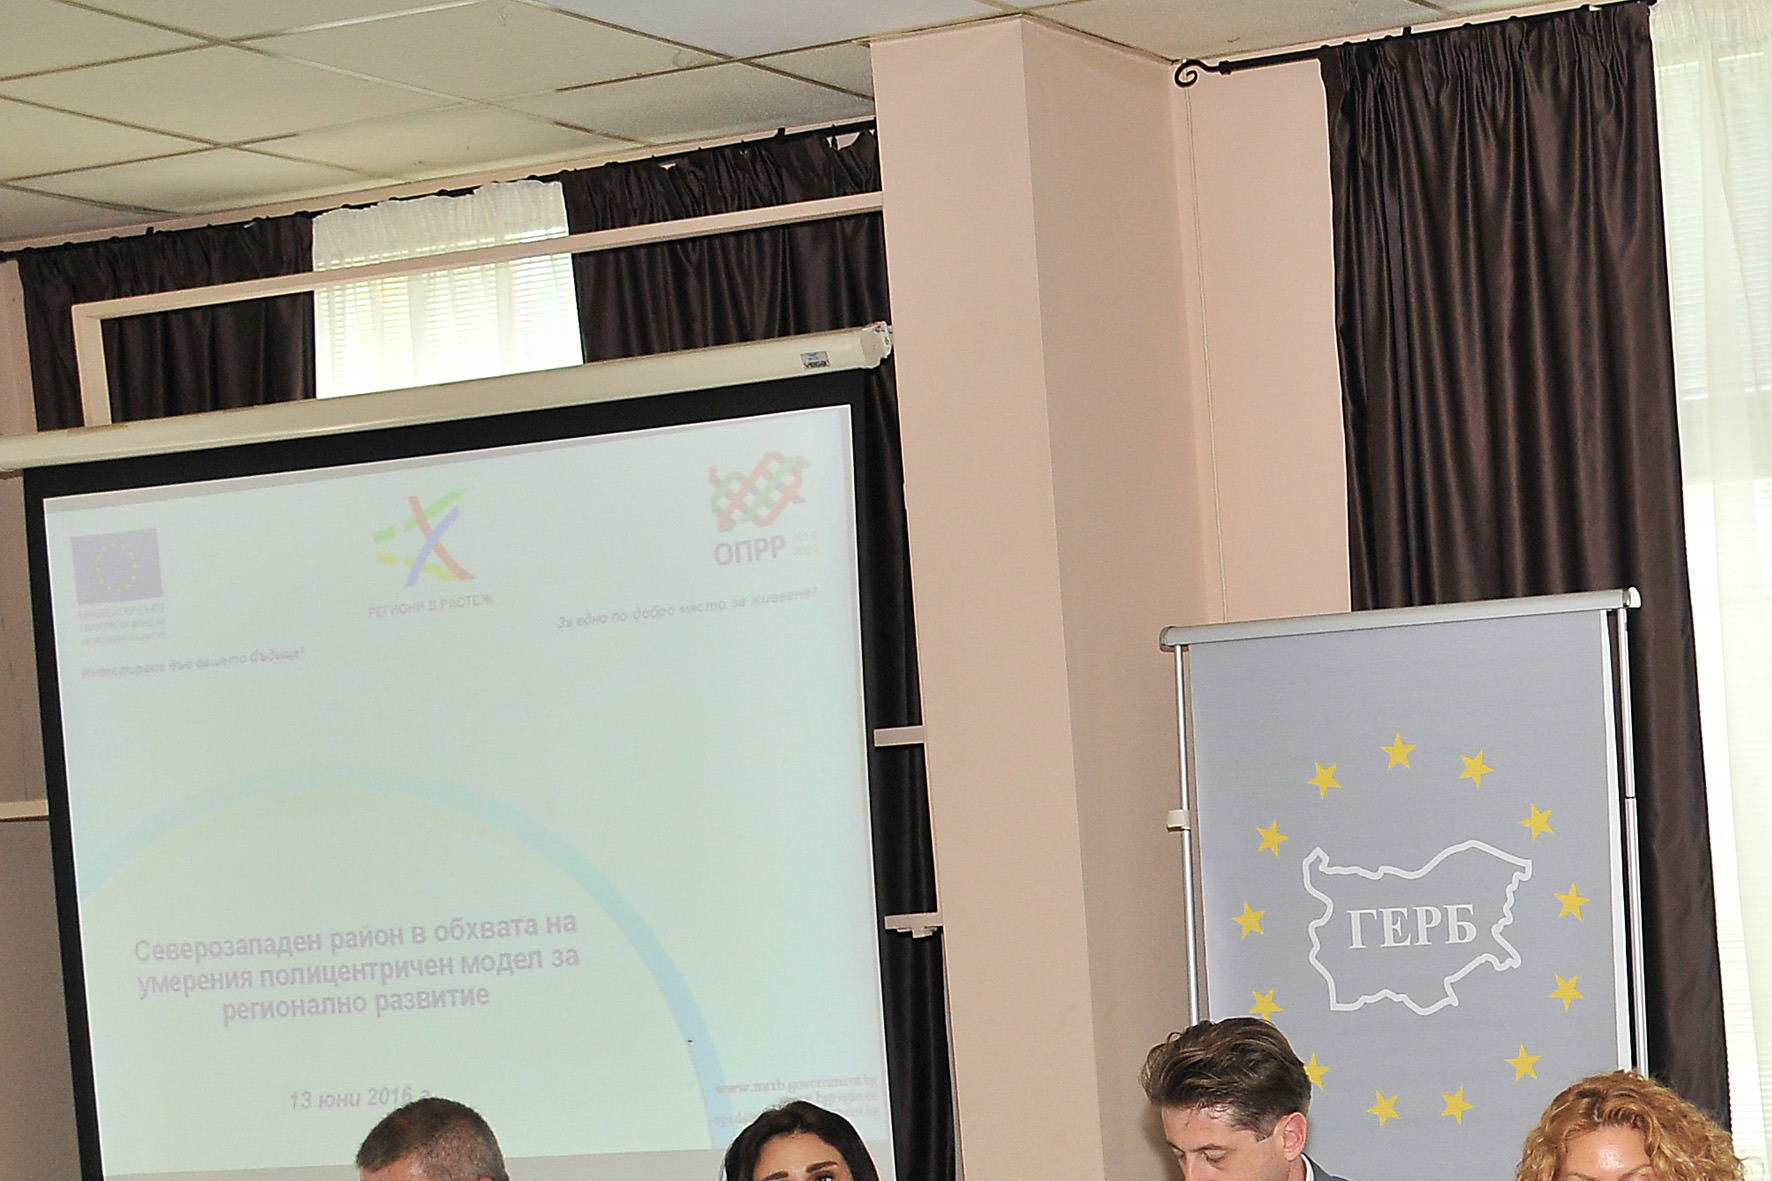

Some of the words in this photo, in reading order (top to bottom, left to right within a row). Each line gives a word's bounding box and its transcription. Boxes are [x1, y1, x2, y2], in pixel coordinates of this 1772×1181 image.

[714, 535, 786, 565] ОПРР
[368, 602, 426, 618] РЕГИОНИ
[429, 600, 437, 611] В
[441, 594, 493, 609] РАСТЕЖ
[557, 616, 572, 629] За
[576, 611, 608, 627] едно
[134, 929, 323, 965] Северозападен
[330, 923, 404, 955] район
[411, 926, 427, 945] в
[434, 915, 539, 943] обхвата
[546, 913, 578, 934] на
[1346, 904, 1477, 949] ГЕРБ
[136, 966, 254, 1000] умерения
[260, 955, 455, 992] полицентричен
[461, 949, 544, 978] модел
[551, 946, 580, 968] за
[222, 992, 367, 1027] регионално
[375, 984, 490, 1018] развитие
[290, 1091, 312, 1110] 13
[318, 1092, 361, 1110] юни
[367, 1086, 413, 1107] 2016
